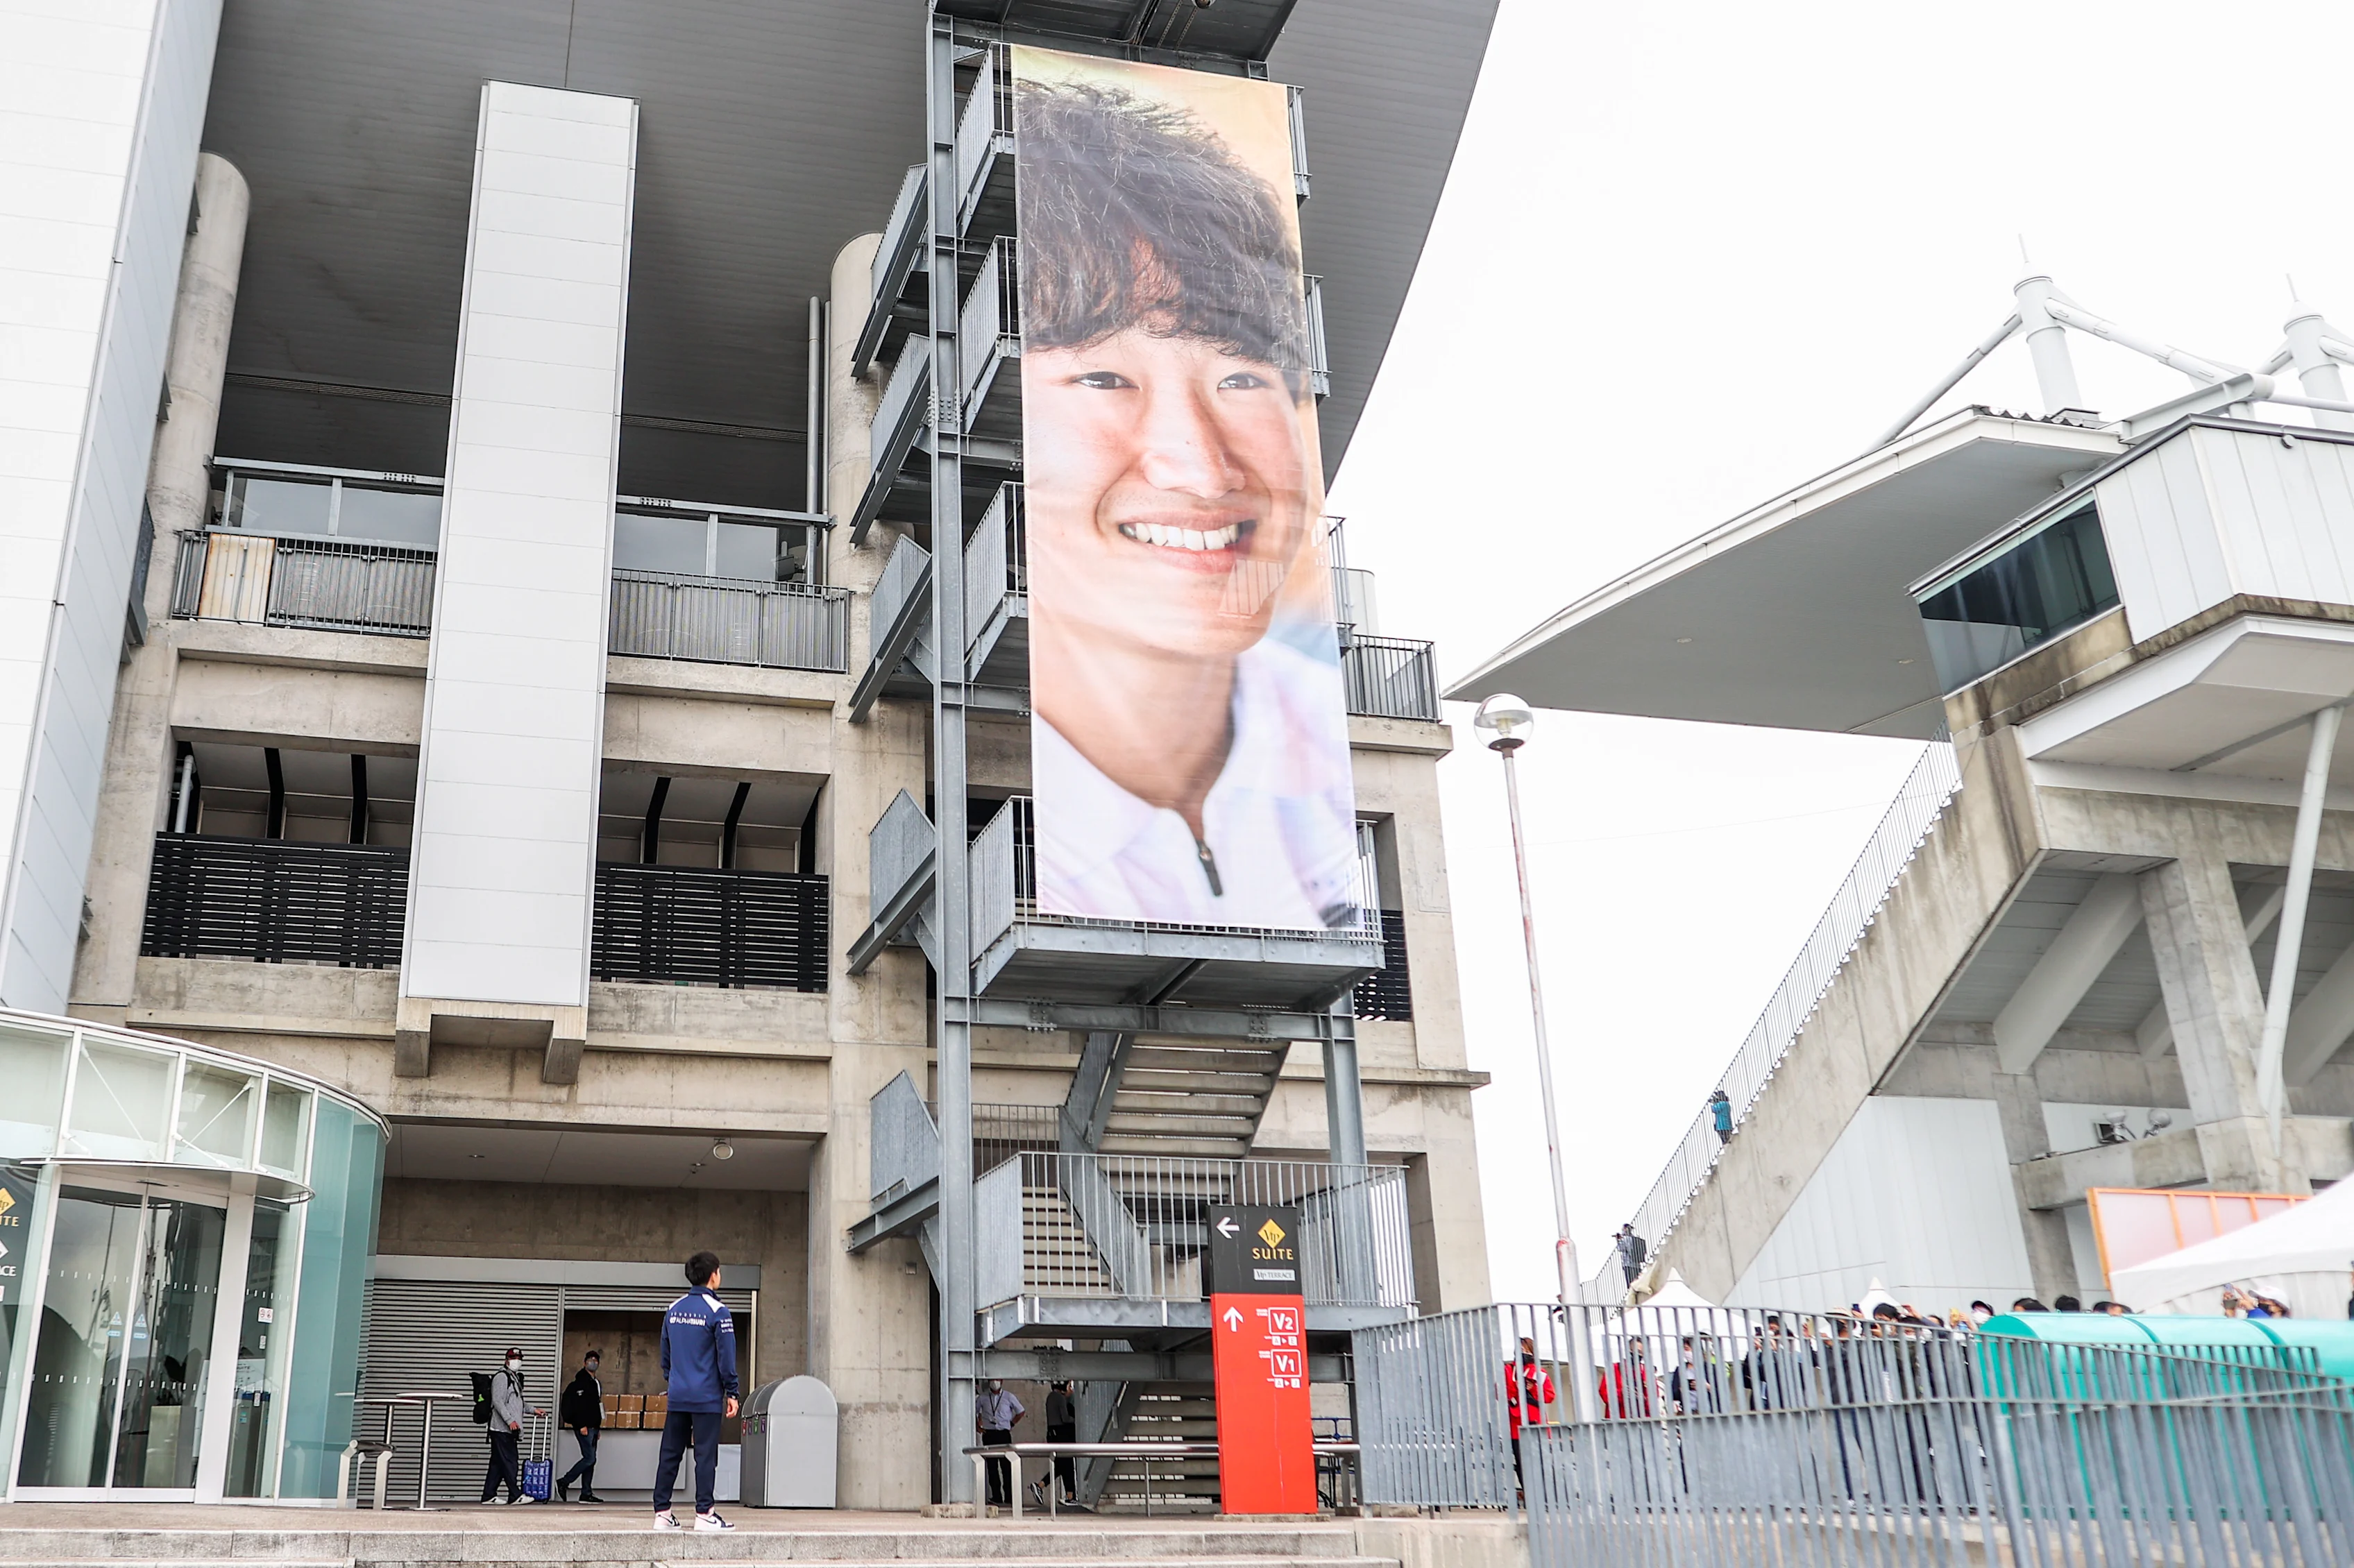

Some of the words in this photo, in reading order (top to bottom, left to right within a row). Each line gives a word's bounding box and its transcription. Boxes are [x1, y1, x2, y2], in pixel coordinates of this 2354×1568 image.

[1252, 1247, 1294, 1261] SUITE
[1273, 1312, 1294, 1330] V2
[1276, 1354, 1295, 1372] V1
